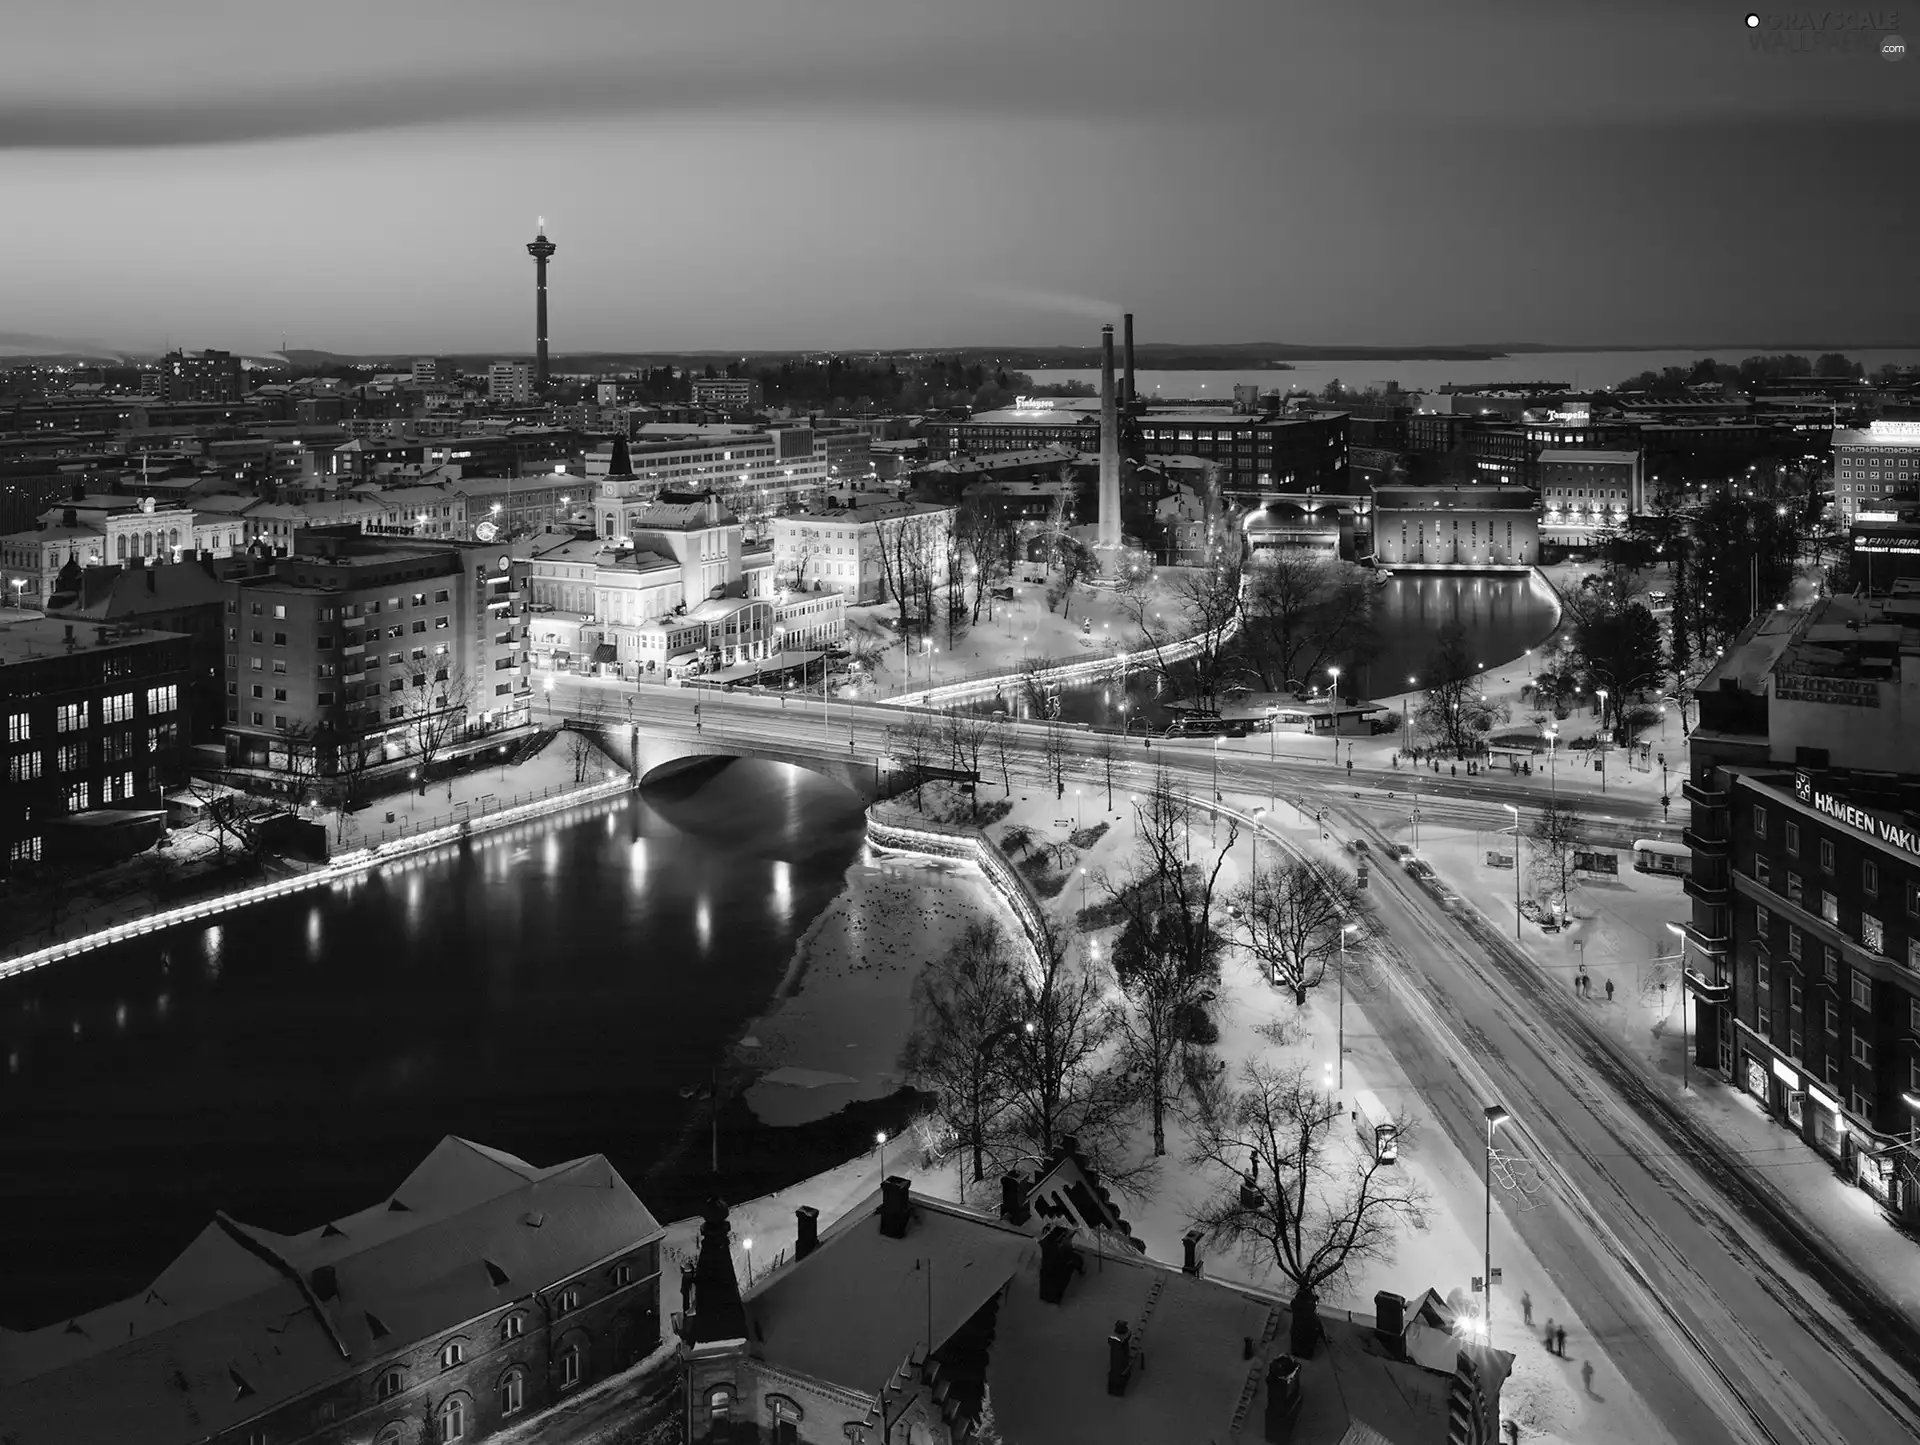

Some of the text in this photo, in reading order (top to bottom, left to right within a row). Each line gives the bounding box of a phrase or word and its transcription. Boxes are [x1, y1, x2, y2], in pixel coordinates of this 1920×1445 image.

[1546, 410, 1590, 421] Tampella
[1867, 537, 1920, 547] FINNAIR
[1815, 791, 1920, 856] HÄMEEN VAKU
